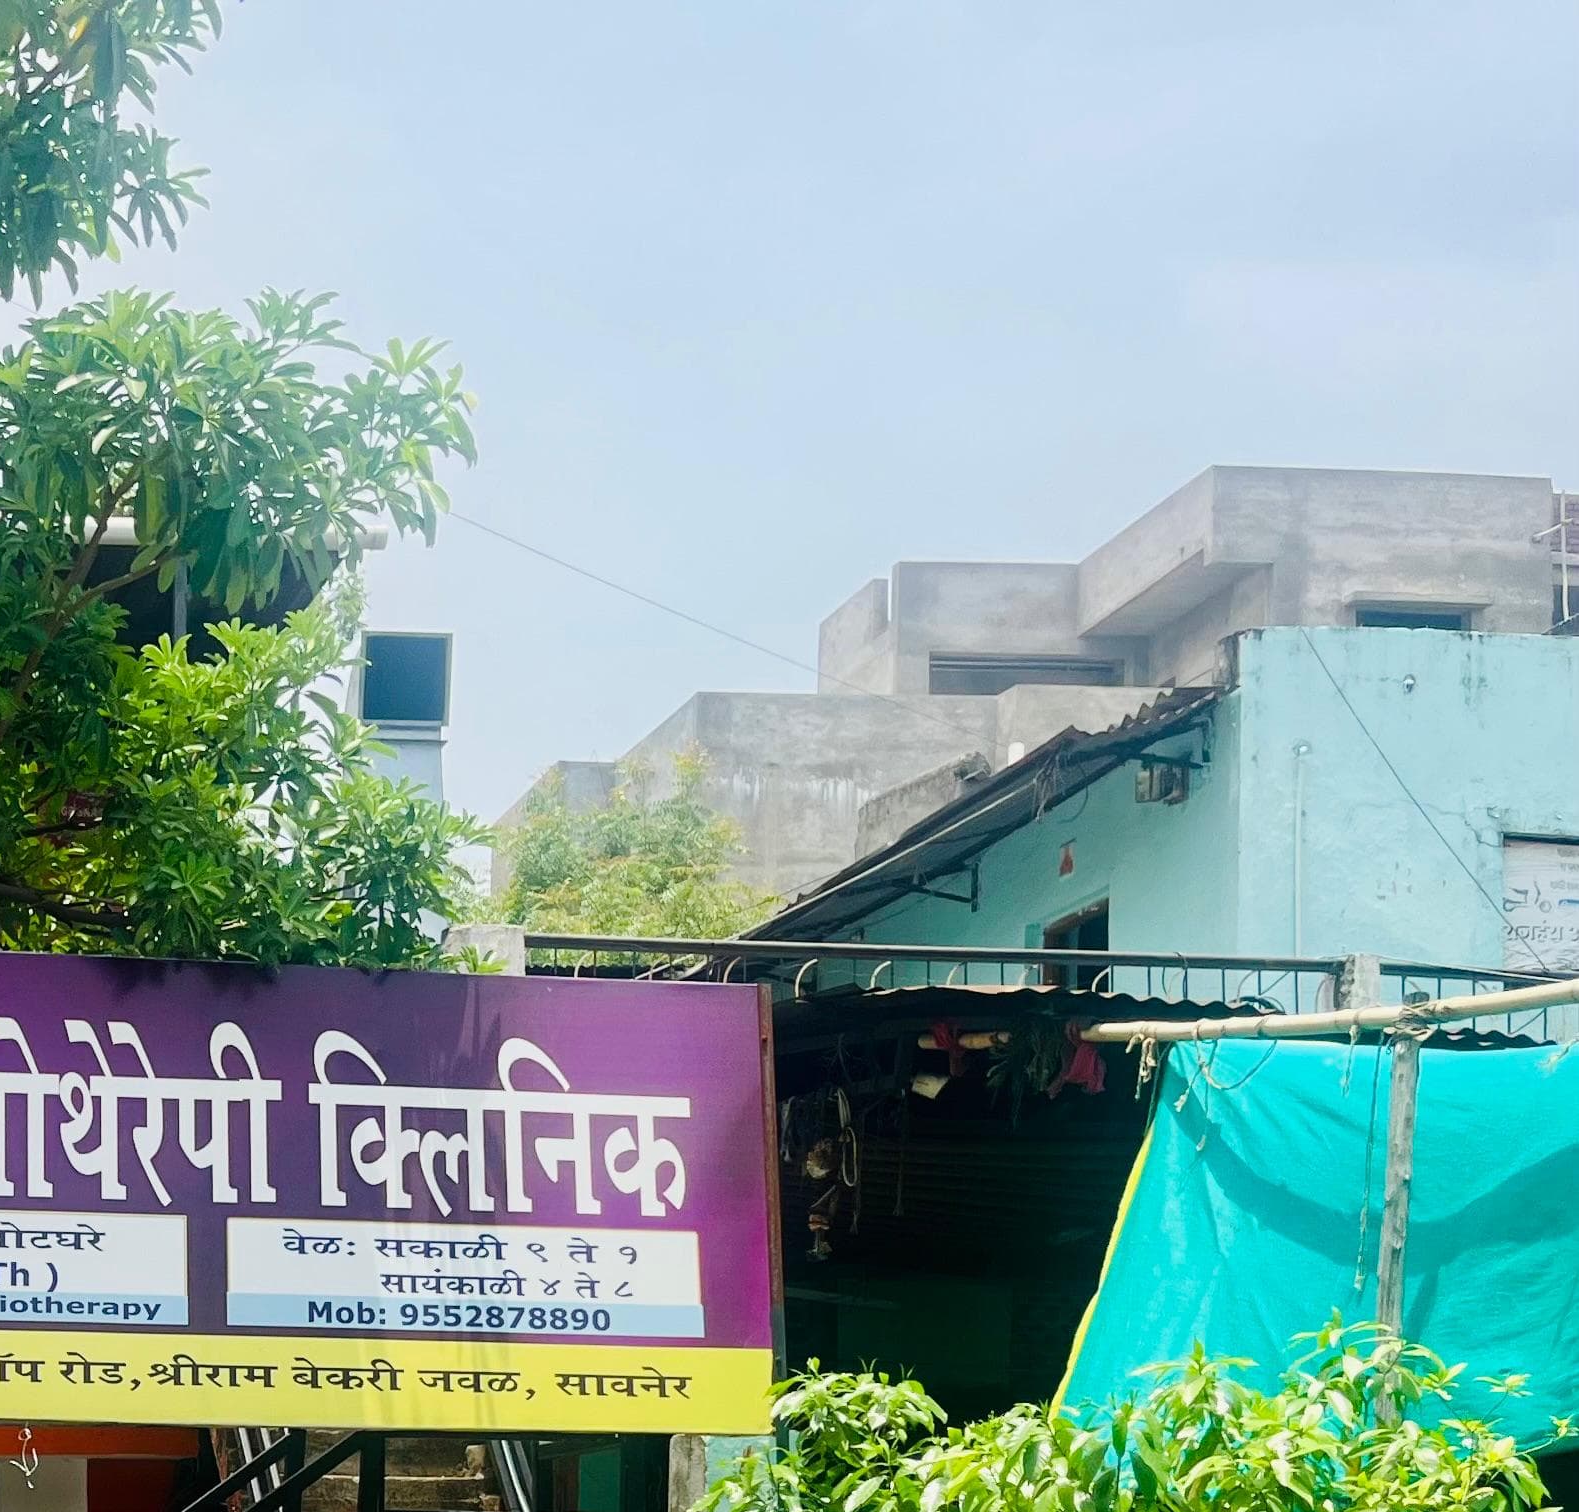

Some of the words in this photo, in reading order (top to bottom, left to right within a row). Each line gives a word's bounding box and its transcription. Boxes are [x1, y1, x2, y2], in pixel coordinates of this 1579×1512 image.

[308, 1029, 691, 1218] क्लिनिक
[281, 1227, 357, 1258] वेळ:
[374, 1233, 509, 1262] सकाळी
[526, 1242, 549, 1264] ९
[567, 1236, 599, 1266] ते
[618, 1245, 638, 1266] १
[379, 1268, 526, 1298] सायंकाळी
[540, 1277, 561, 1297] ४
[574, 1273, 601, 1300] ते
[613, 1280, 635, 1299] ८
[307, 1301, 387, 1326] Mob:
[399, 1302, 611, 1332] 9552878890
[291, 1357, 405, 1391] बेकरी
[417, 1368, 538, 1400] जवळ,
[554, 1366, 694, 1399] सावनेर
